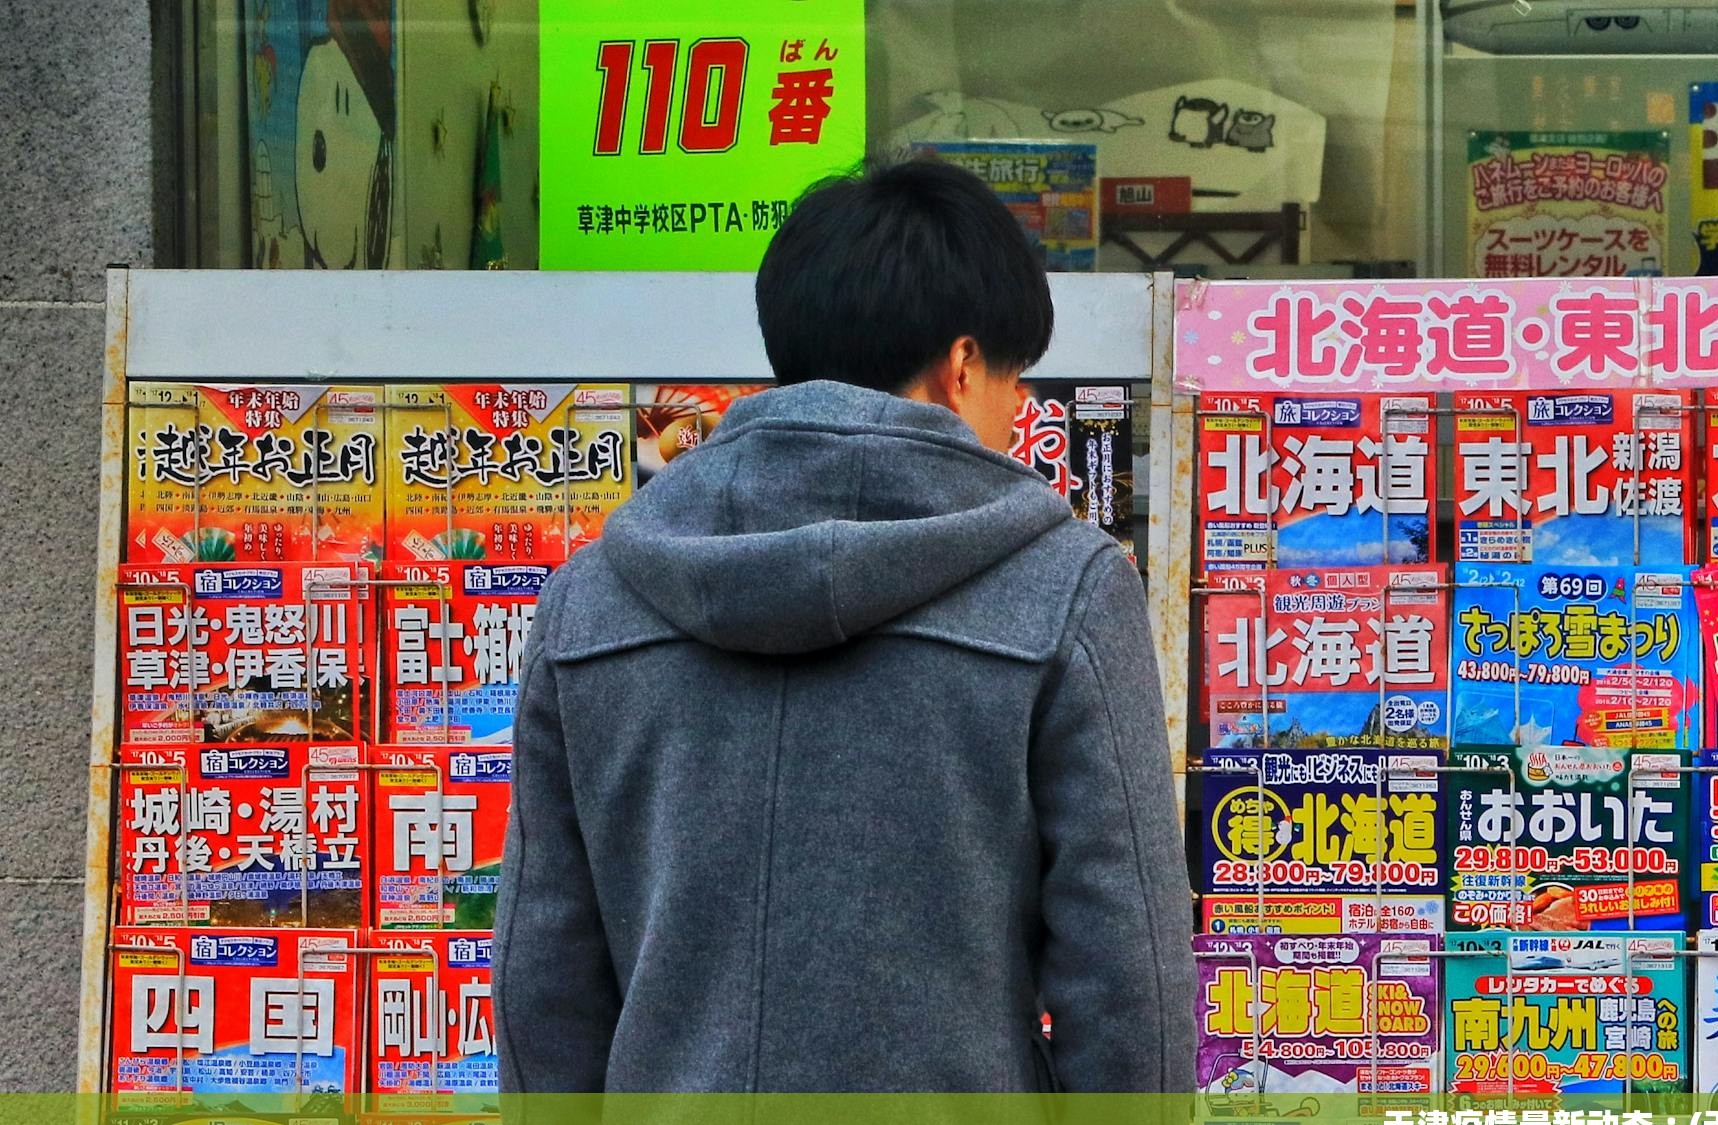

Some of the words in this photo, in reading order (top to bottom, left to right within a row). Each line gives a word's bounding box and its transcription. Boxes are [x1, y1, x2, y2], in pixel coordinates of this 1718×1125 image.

[779, 39, 838, 61] ばん
[592, 36, 749, 156] 110
[768, 69, 834, 146] 番
[1486, 229, 1649, 251] スーツケースを
[1484, 254, 1627, 277] 無料レンタル
[228, 392, 300, 410] 年末年始
[245, 410, 281, 428] 特集
[153, 429, 376, 487] 越年お正月
[402, 429, 624, 487] 越年お正月
[1206, 435, 1429, 517] 北海道
[1458, 435, 1609, 518] 東北
[221, 576, 282, 592] コレクション
[1274, 594, 1382, 613] 観光周遊プラン
[1541, 575, 1603, 597] 第69回
[127, 604, 346, 646] 日光・鬼怒川
[1460, 605, 1680, 661] さっぽろ雪まつり
[127, 648, 348, 688] 草津・伊香保
[1217, 616, 1436, 689] 北海道
[132, 787, 359, 833] 城崎・湯村
[1290, 795, 1438, 865] 北海道
[1459, 790, 1473, 842] おんせん県
[1479, 789, 1674, 844] おおいた
[132, 834, 361, 872] 丹後・天橋立
[1461, 875, 1527, 888] 往復新幹線
[1293, 951, 1341, 961] 期間も掲載!!
[1572, 940, 1604, 950] JAL
[1487, 977, 1640, 993] レンタカーでめぐる
[131, 975, 335, 1056] 四国
[1453, 998, 1597, 1052] 南九州
